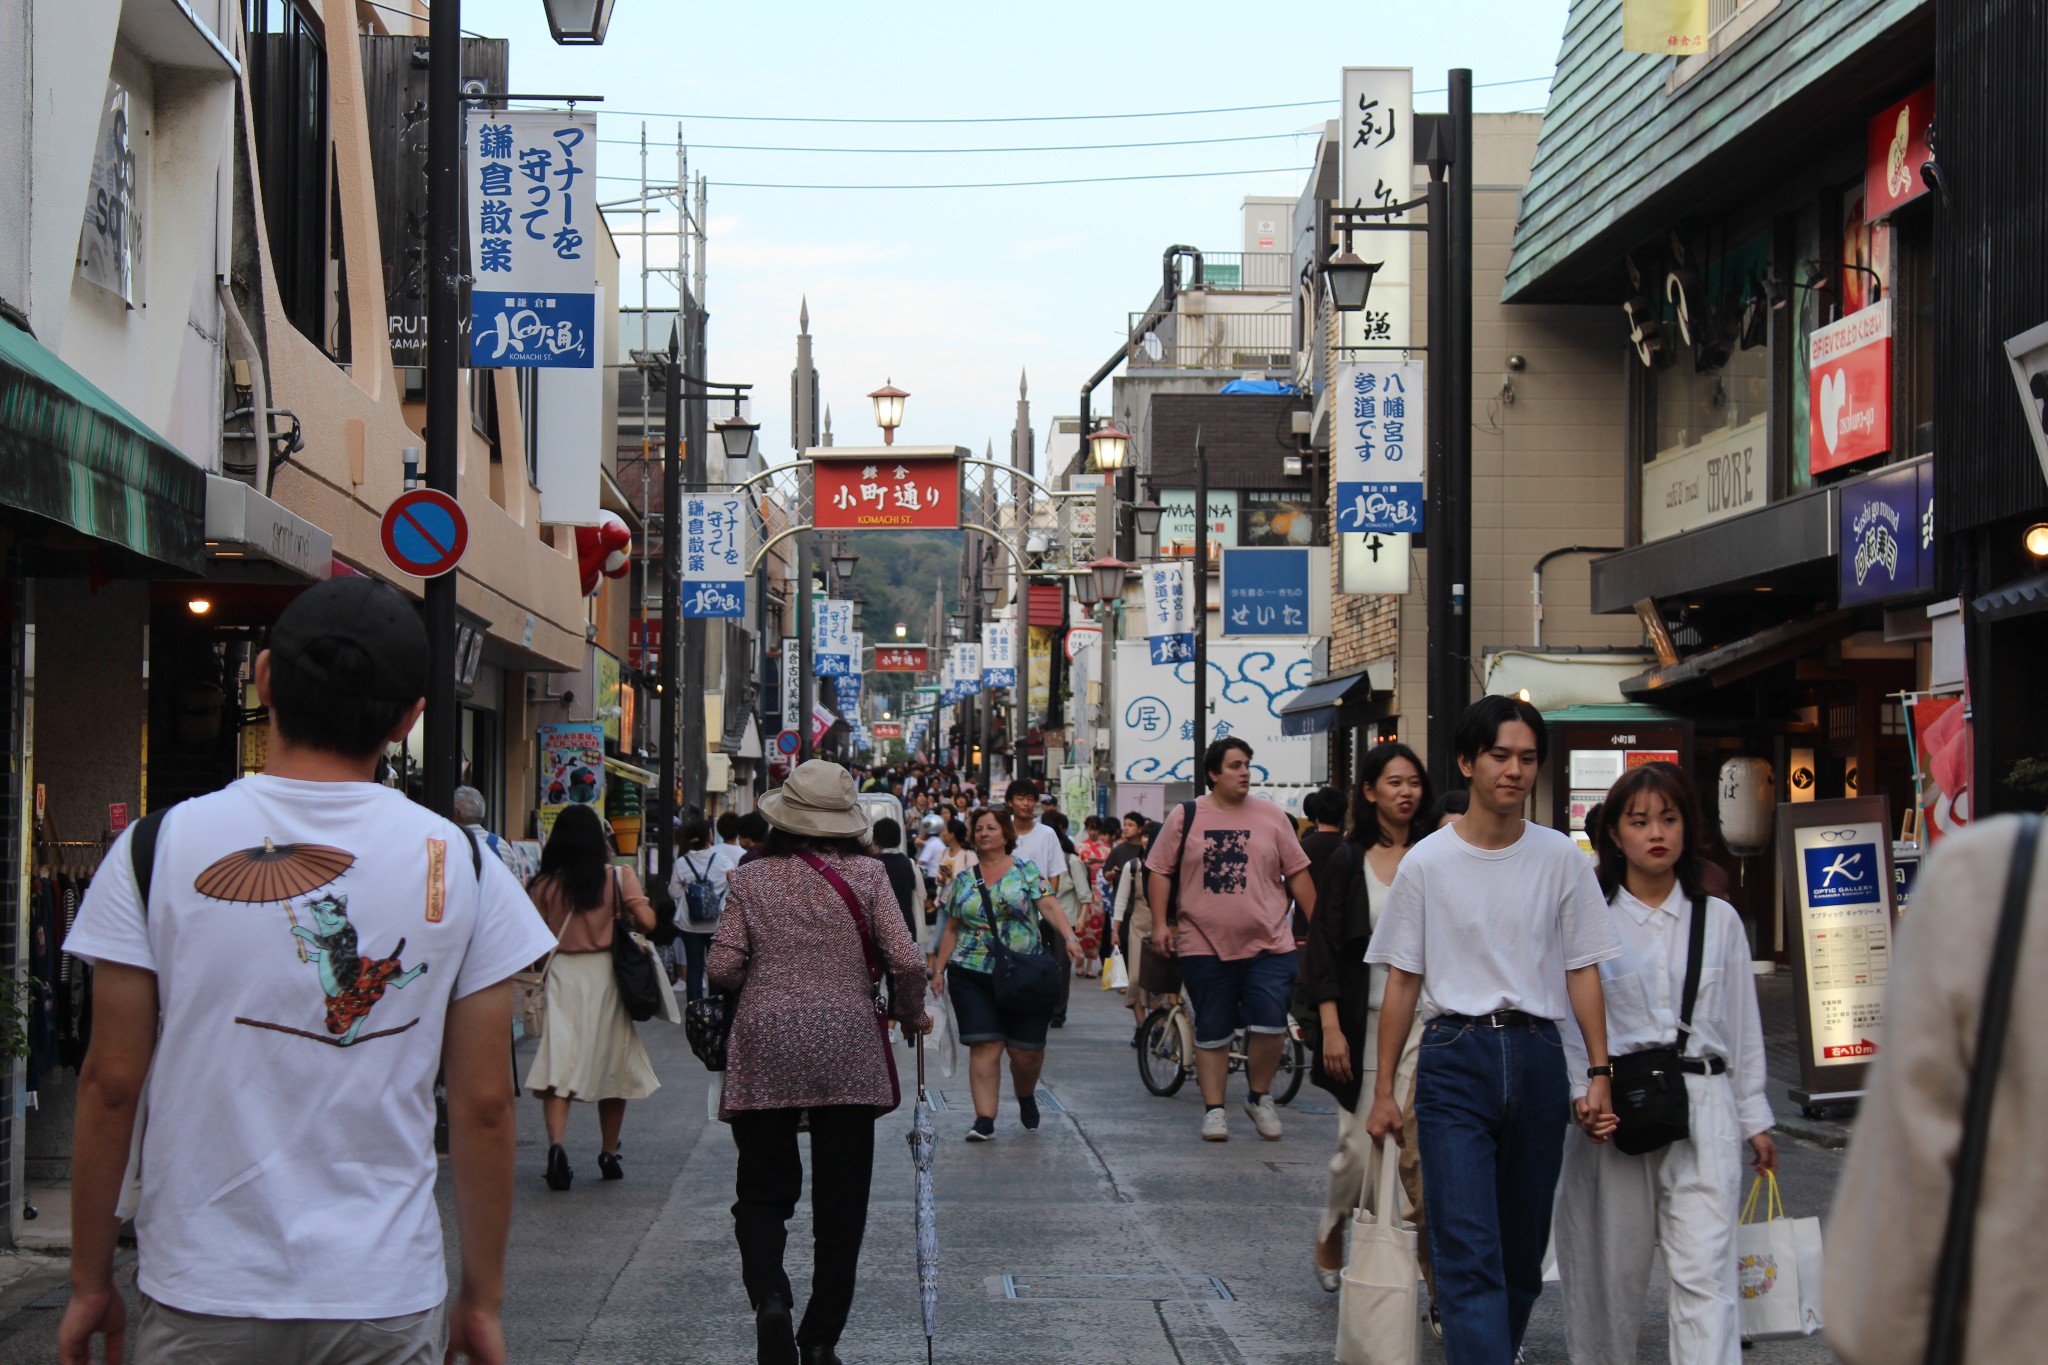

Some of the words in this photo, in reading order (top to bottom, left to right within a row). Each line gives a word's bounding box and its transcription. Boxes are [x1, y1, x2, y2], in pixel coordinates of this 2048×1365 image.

[479, 123, 514, 273] 鎌倉散策
[519, 147, 552, 240] 守って
[553, 127, 584, 260] マナーを
[517, 298, 544, 308] 鎌倉
[475, 310, 586, 359] 小町通り
[509, 353, 543, 361] KOMACHI
[1354, 372, 1377, 463] 参道です
[1382, 372, 1405, 462] 八幡宮の
[862, 465, 910, 480] 鎌倉
[1707, 446, 1753, 514] MORE
[833, 482, 940, 510] 小町通り
[688, 500, 705, 572] 鎌倉散策
[707, 511, 723, 555] 守って
[724, 501, 739, 565] マナーを
[858, 516, 899, 524] KOMACHI
[901, 516, 913, 524] ST.
[1853, 501, 1872, 542] Sushi
[1871, 501, 1880, 523] go
[1880, 501, 1900, 533] round
[1153, 571, 1170, 623] 参道です
[1171, 569, 1183, 621] 八幡宮の
[1231, 603, 1303, 625] せいた
[840, 605, 850, 645] マナーを
[1822, 853, 1864, 888] K
[1838, 885, 1873, 893] GALLERY
[1831, 1045, 1873, 1057] 右へ10m
